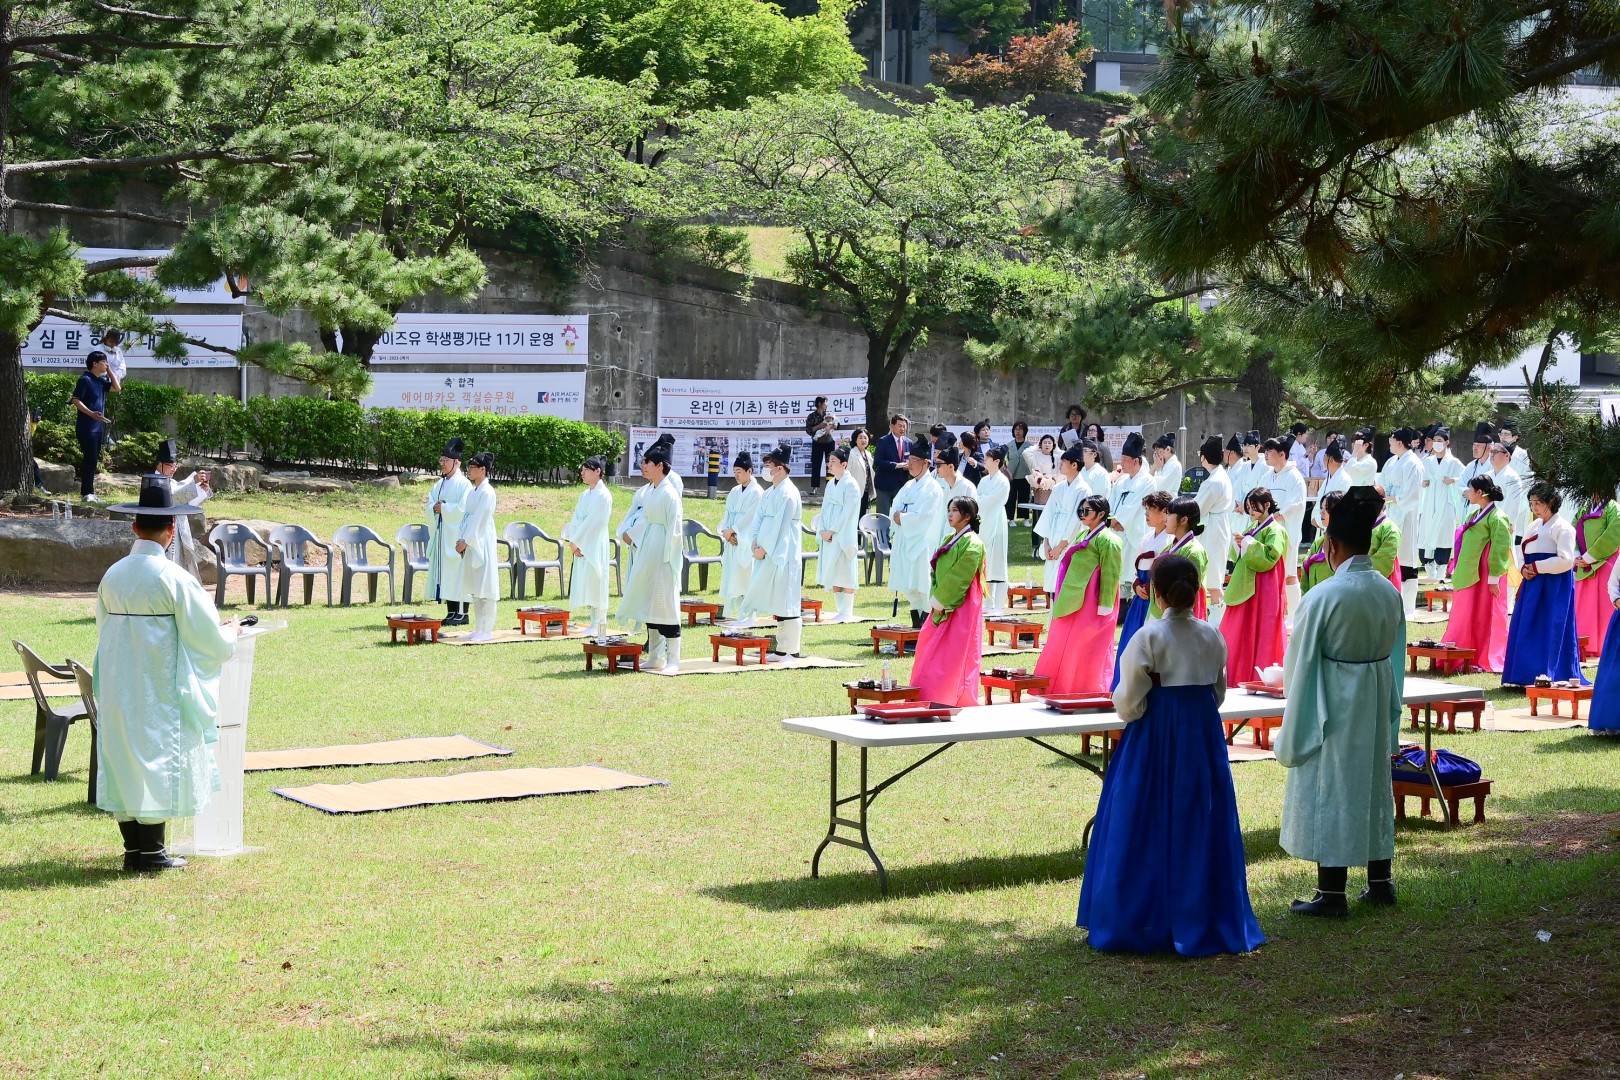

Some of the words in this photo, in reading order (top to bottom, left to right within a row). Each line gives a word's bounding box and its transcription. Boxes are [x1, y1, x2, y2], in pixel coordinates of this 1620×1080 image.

[375, 332, 421, 346] 이즈유
[426, 332, 491, 346] 학생평가단
[497, 332, 524, 346] 11기
[529, 332, 554, 347] 운영
[458, 378, 474, 388] 합격
[402, 392, 456, 403] 에어마카오
[462, 392, 515, 403] 객실승무원
[690, 400, 724, 414] 온라인
[730, 400, 762, 415] (기초)
[768, 400, 800, 414] 학습법
[832, 398, 854, 412] 안내
